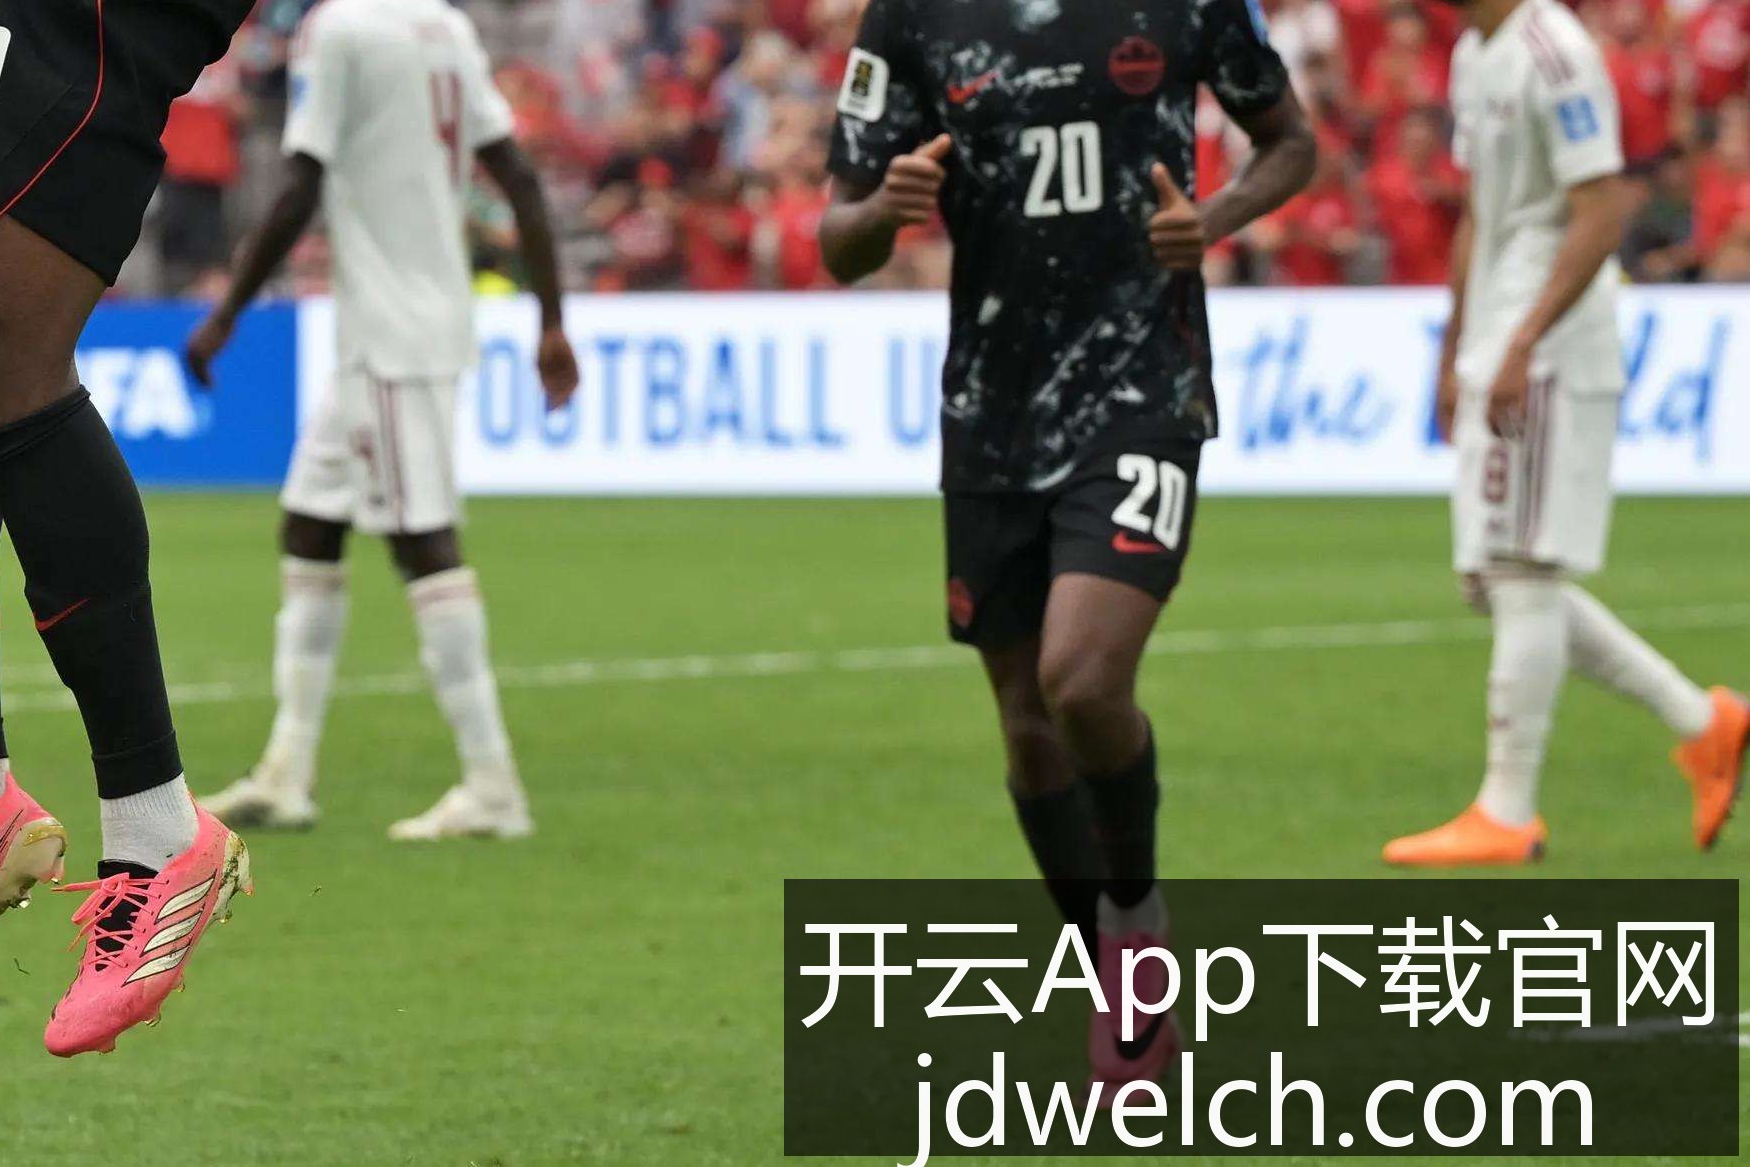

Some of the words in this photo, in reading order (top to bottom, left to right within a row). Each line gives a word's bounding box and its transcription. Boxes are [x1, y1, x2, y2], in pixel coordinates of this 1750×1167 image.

[430, 70, 463, 185] 4
[1020, 120, 1104, 218] 20
[77, 346, 198, 440] FA
[479, 337, 850, 448] OTBALL
[1234, 314, 1394, 453] the
[1110, 453, 1188, 552] 20
